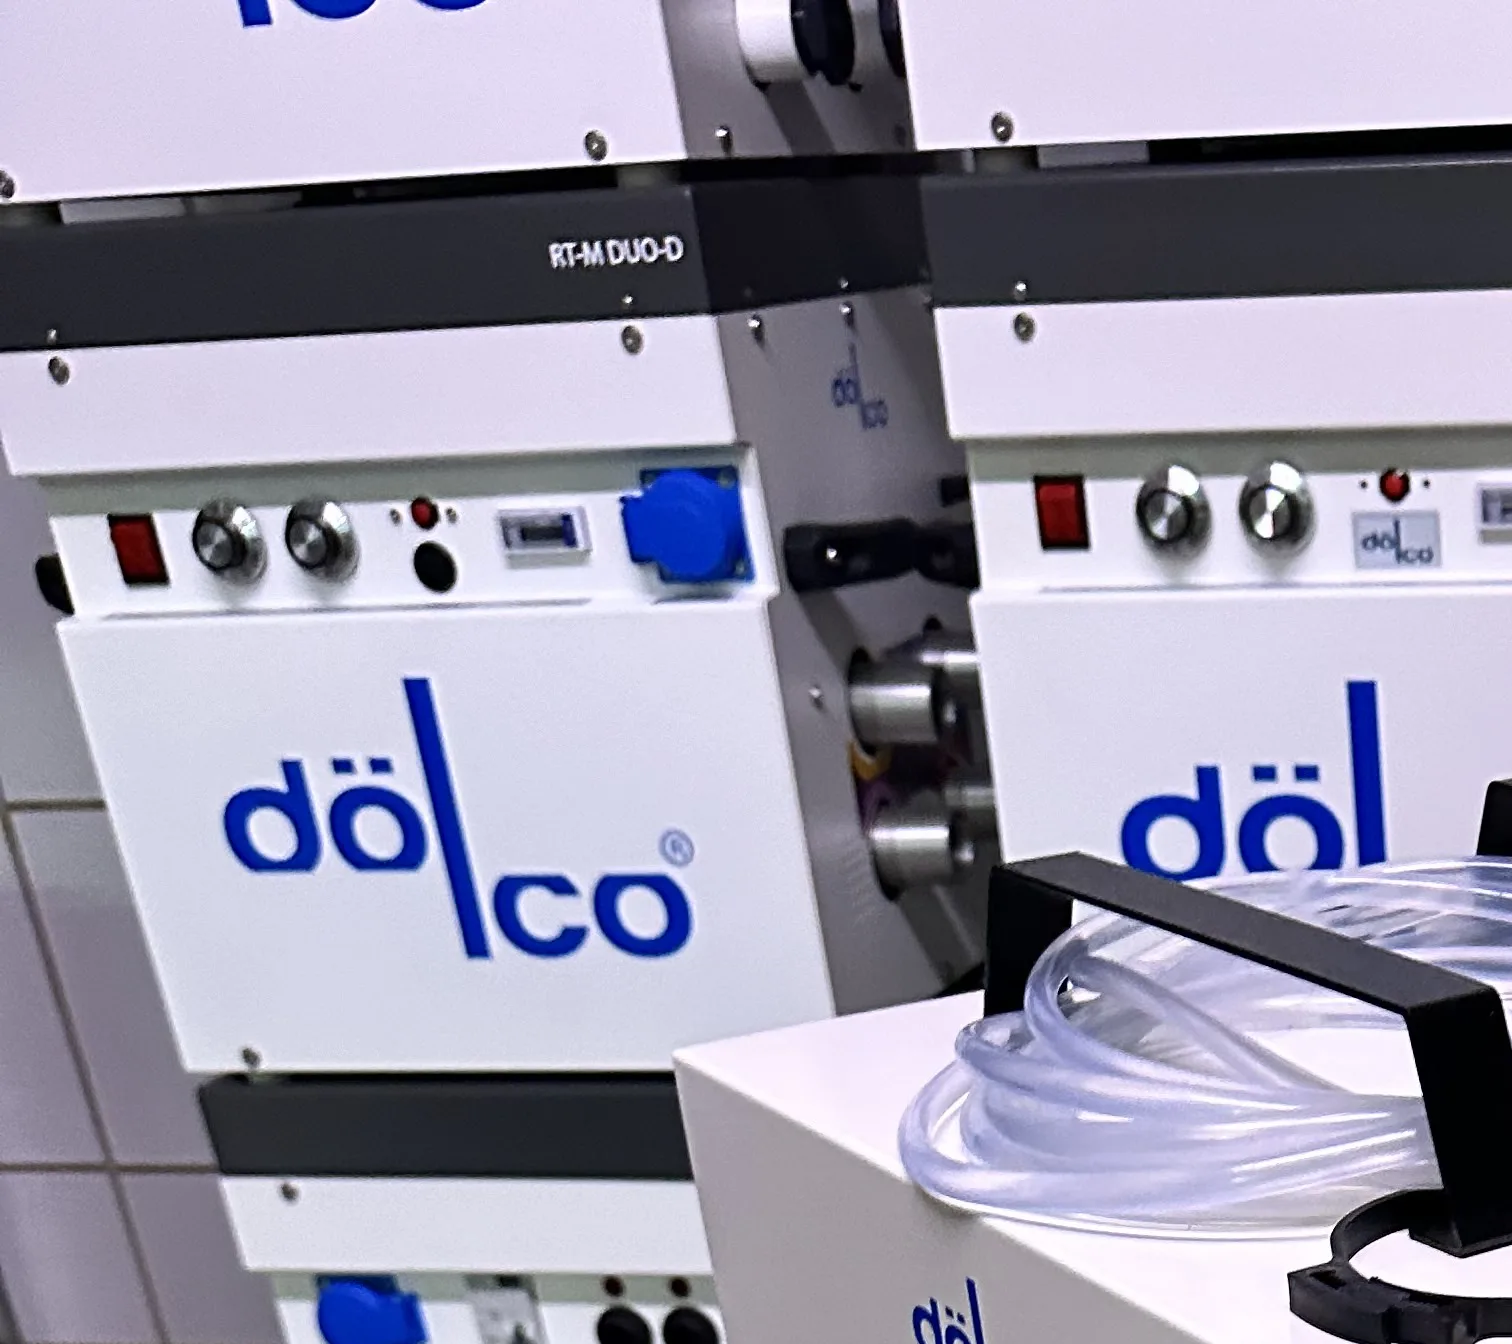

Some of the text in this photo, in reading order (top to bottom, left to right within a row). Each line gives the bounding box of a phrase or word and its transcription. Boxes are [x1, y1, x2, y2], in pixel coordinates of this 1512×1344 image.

[548, 235, 684, 269] RT-M DUO-D
[1120, 680, 1387, 882] döl
